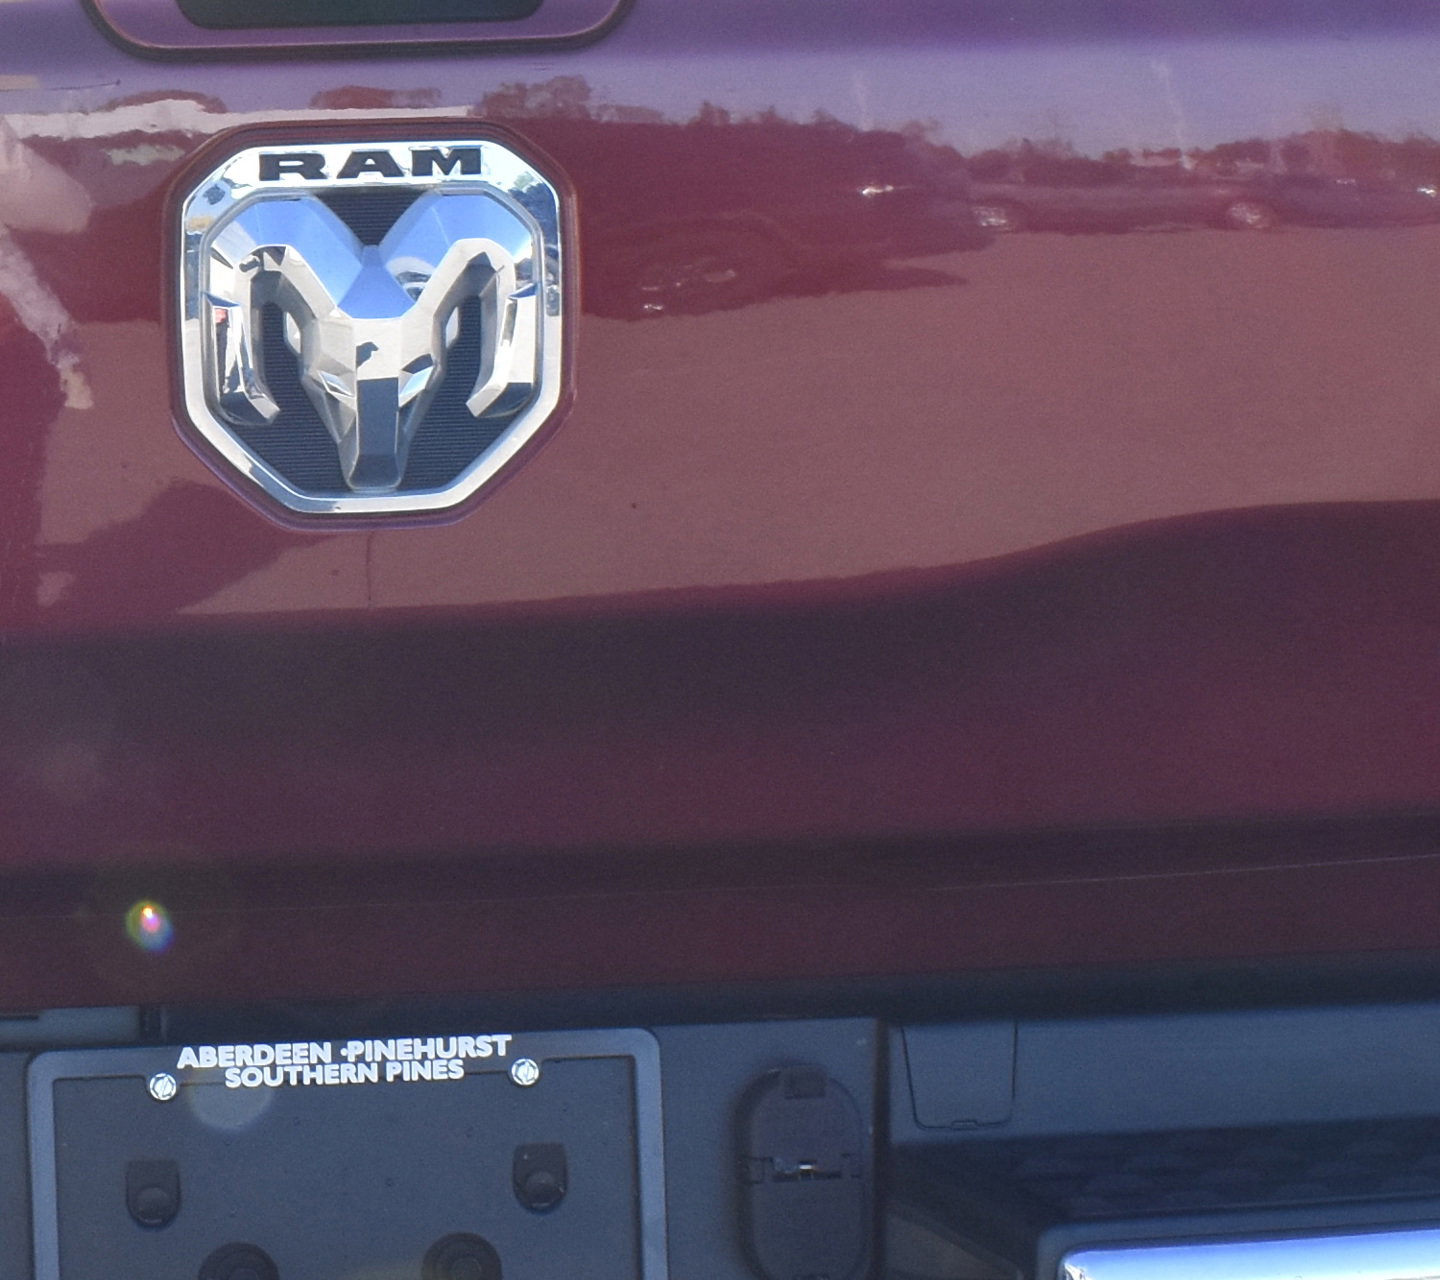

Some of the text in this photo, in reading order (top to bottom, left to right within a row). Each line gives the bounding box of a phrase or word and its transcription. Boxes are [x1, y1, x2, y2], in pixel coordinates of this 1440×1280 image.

[258, 146, 483, 182] RAM
[176, 1042, 333, 1069] ABERDEEN
[224, 1058, 465, 1088] SOUTHERN PINES
